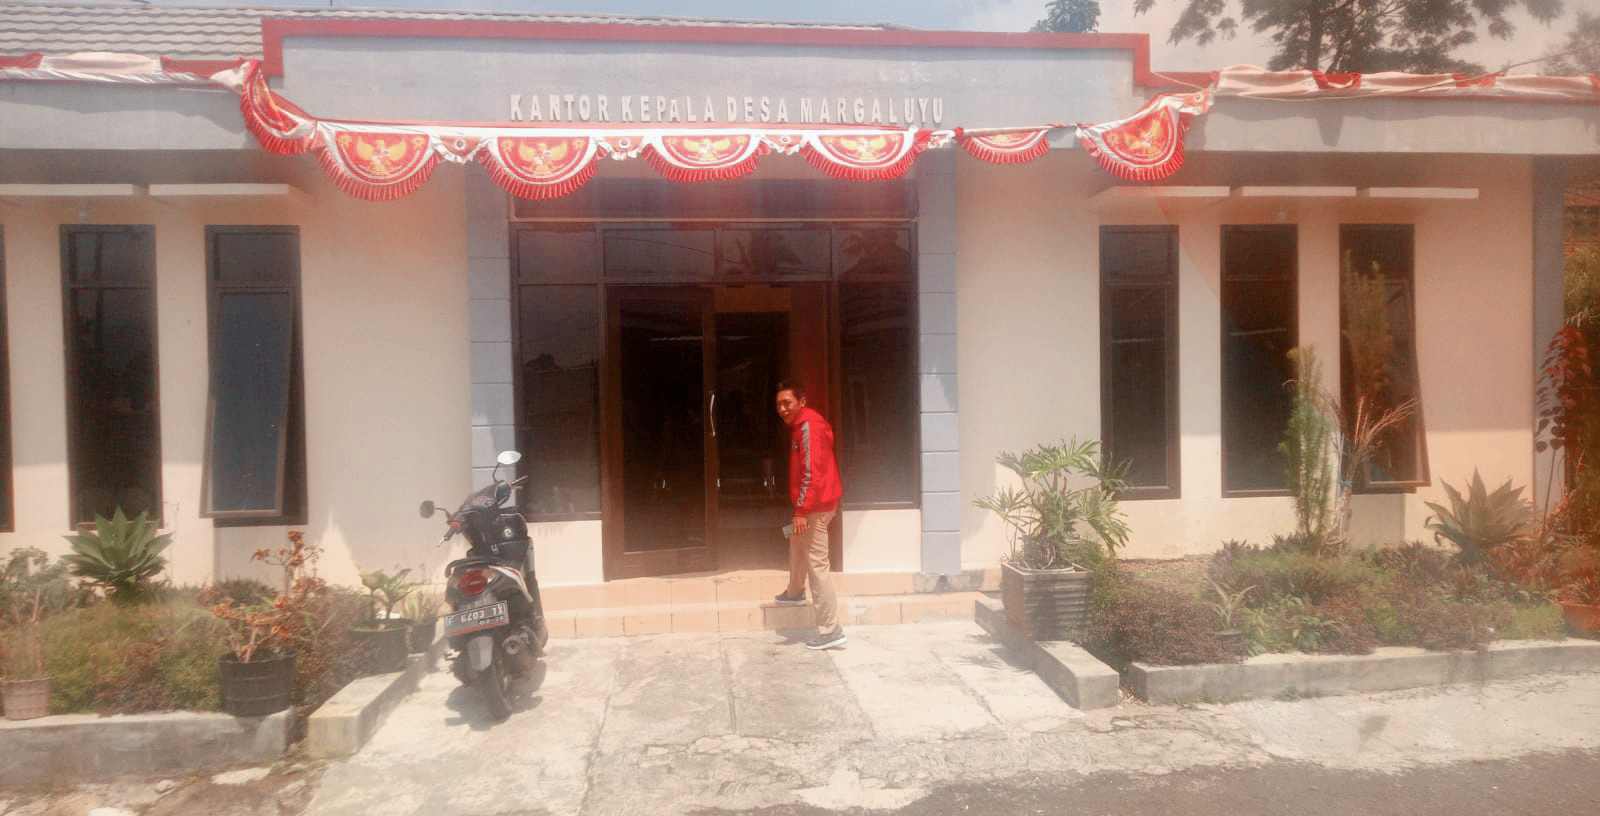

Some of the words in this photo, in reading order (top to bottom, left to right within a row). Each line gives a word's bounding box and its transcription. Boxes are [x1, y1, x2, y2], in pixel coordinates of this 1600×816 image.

[509, 94, 610, 121] KANTOR
[621, 95, 715, 122] KEPALA
[726, 96, 789, 122] DESA
[800, 97, 944, 123] MARGALUYU
